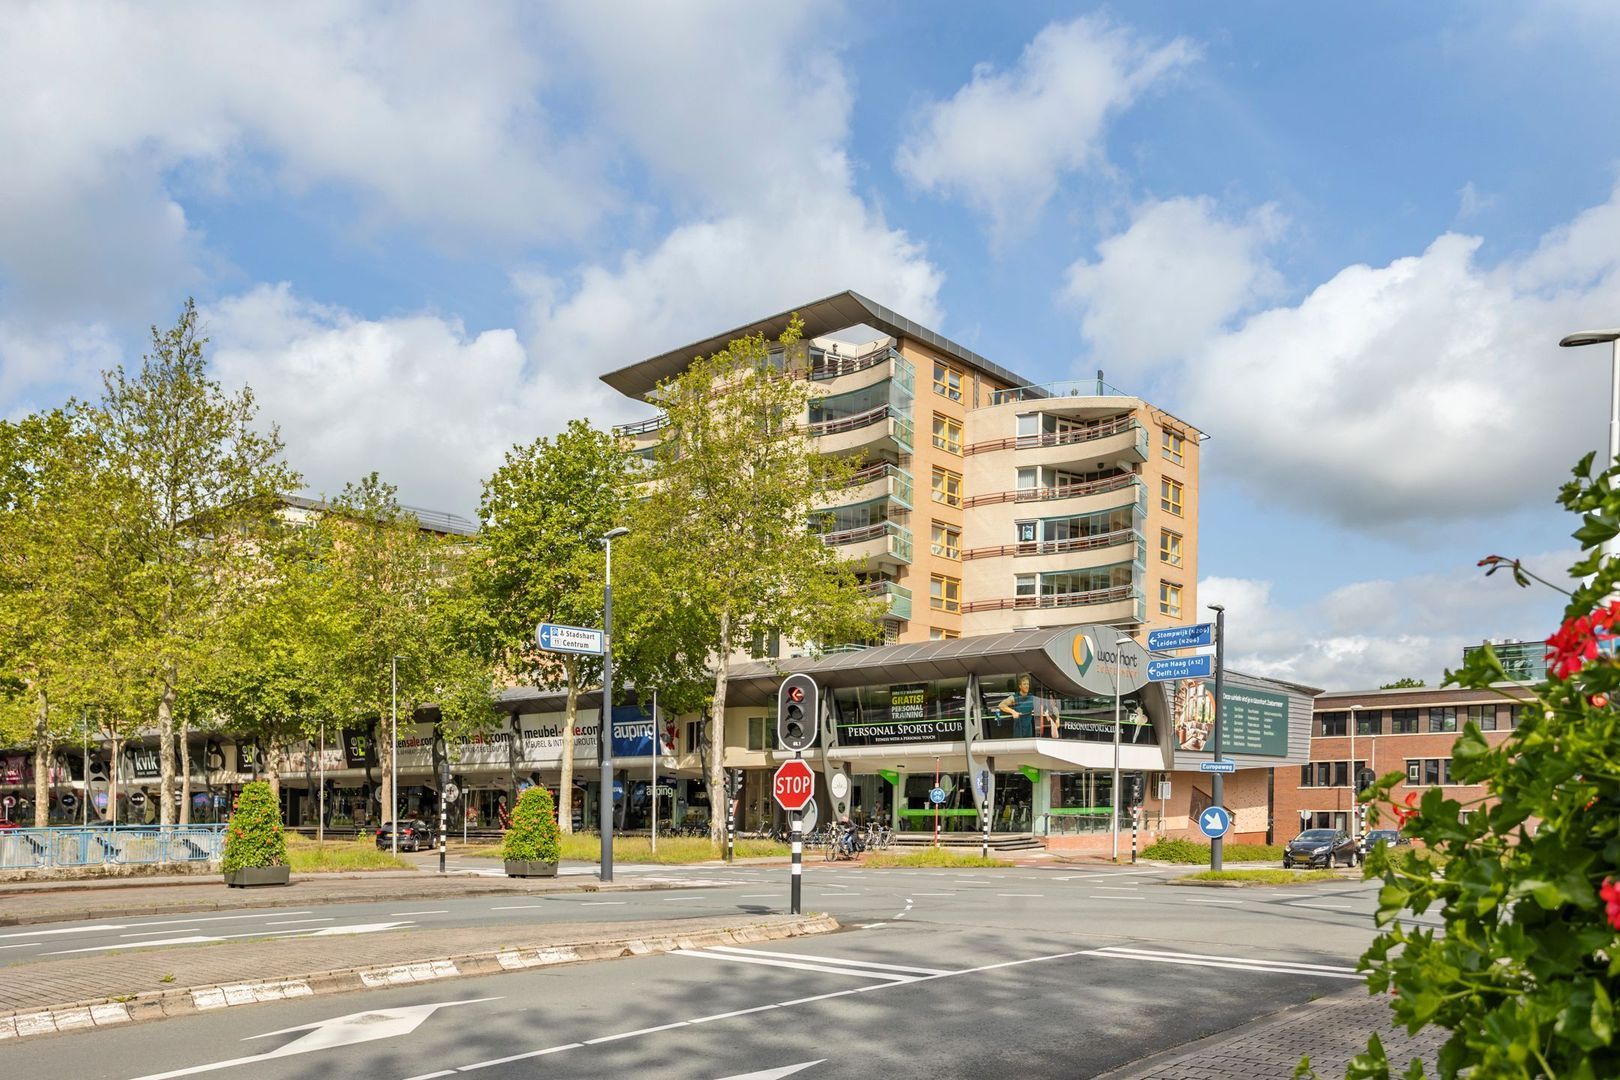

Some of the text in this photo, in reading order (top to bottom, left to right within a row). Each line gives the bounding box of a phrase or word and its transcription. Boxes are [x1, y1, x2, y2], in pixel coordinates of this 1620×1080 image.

[565, 631, 595, 640] Stadshart
[1157, 630, 1188, 639] Stompwijk
[562, 639, 590, 649] Centrum
[891, 694, 924, 705] GRATIS!
[891, 704, 924, 712] PERSONAL
[891, 711, 924, 719] TRAINING
[613, 721, 655, 741] auping
[848, 722, 963, 737] PERSONAL SPORTS CLUB
[134, 750, 158, 771] kvik
[1202, 763, 1233, 771] Europaweg
[776, 776, 810, 794] STOP
[645, 785, 673, 798] aping
